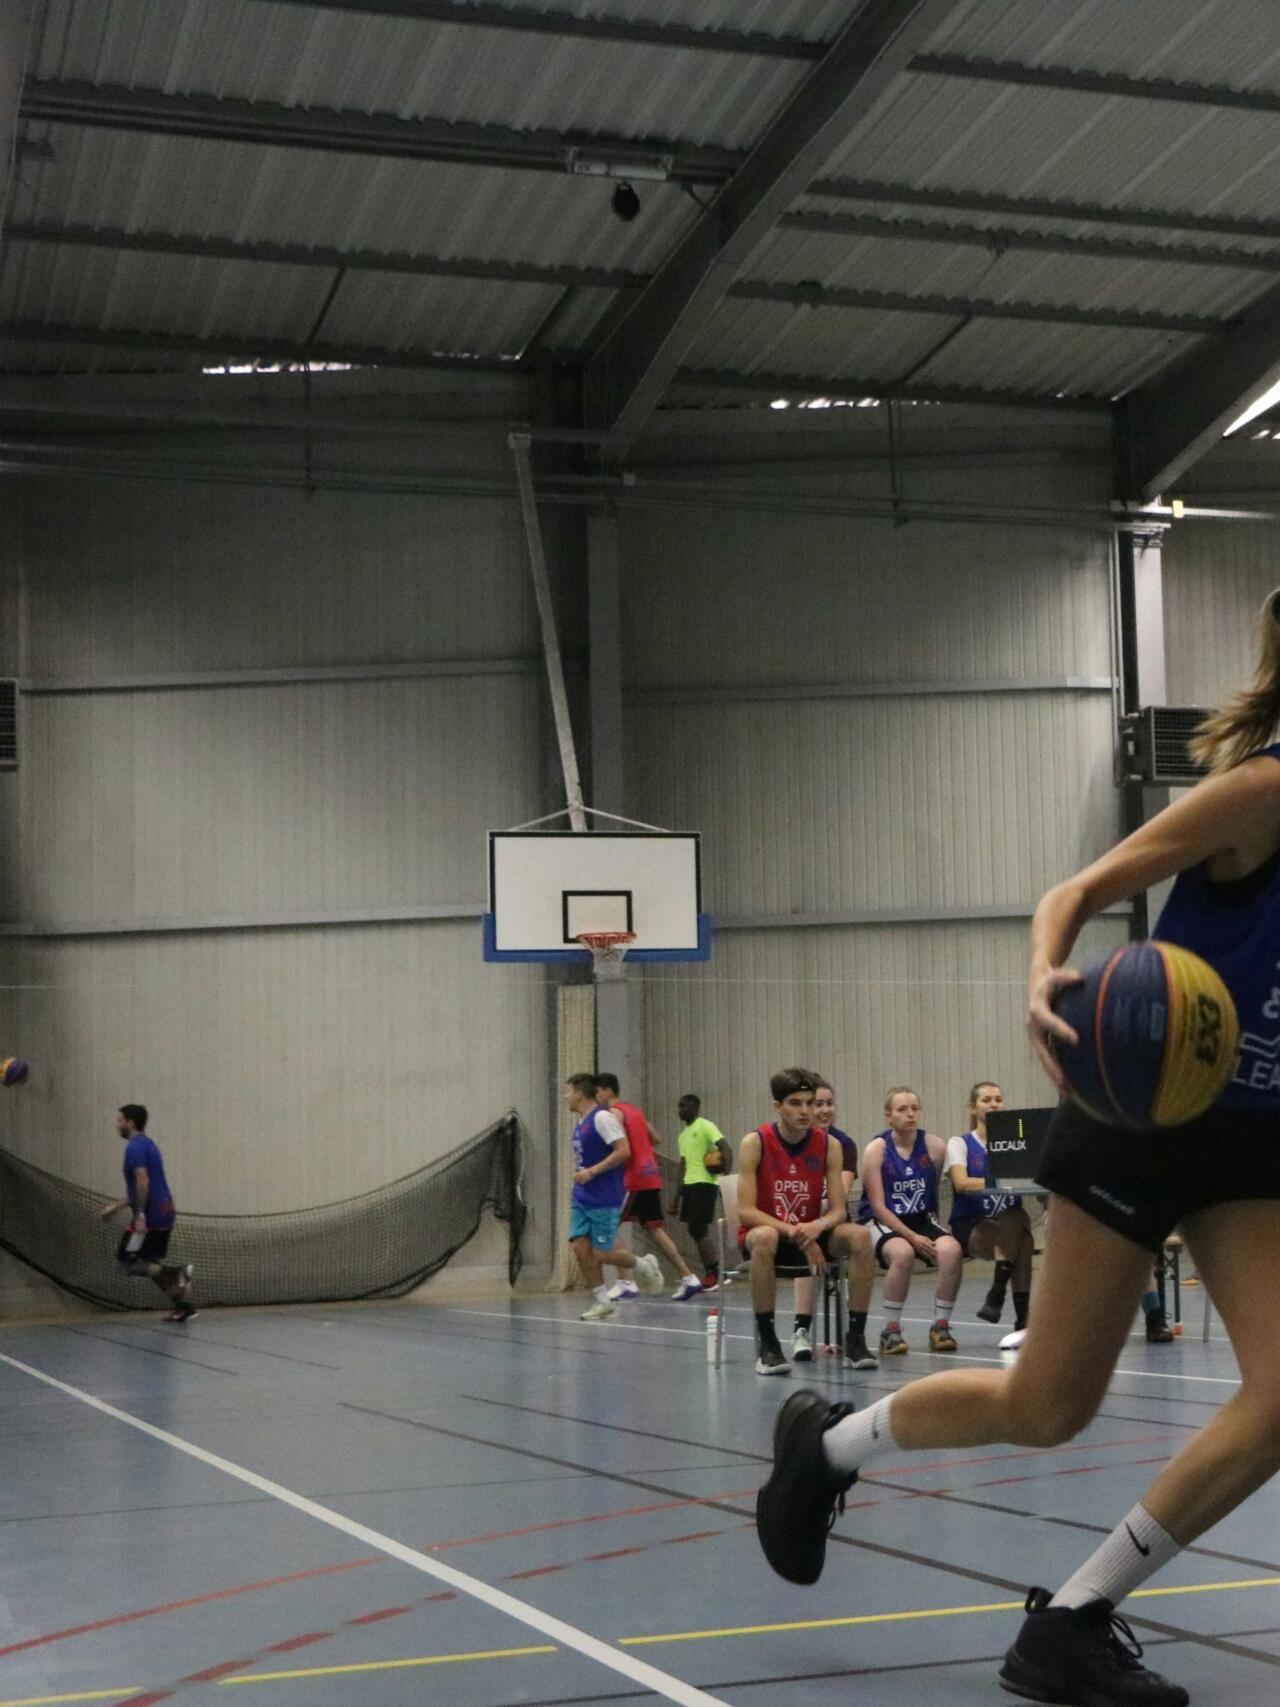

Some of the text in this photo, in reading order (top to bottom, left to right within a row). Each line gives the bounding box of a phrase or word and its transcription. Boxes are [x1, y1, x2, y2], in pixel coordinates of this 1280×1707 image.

[989, 1140, 1027, 1152] LOCAUX
[774, 1179, 809, 1194] OPEN
[893, 1178, 926, 1193] OPEN
